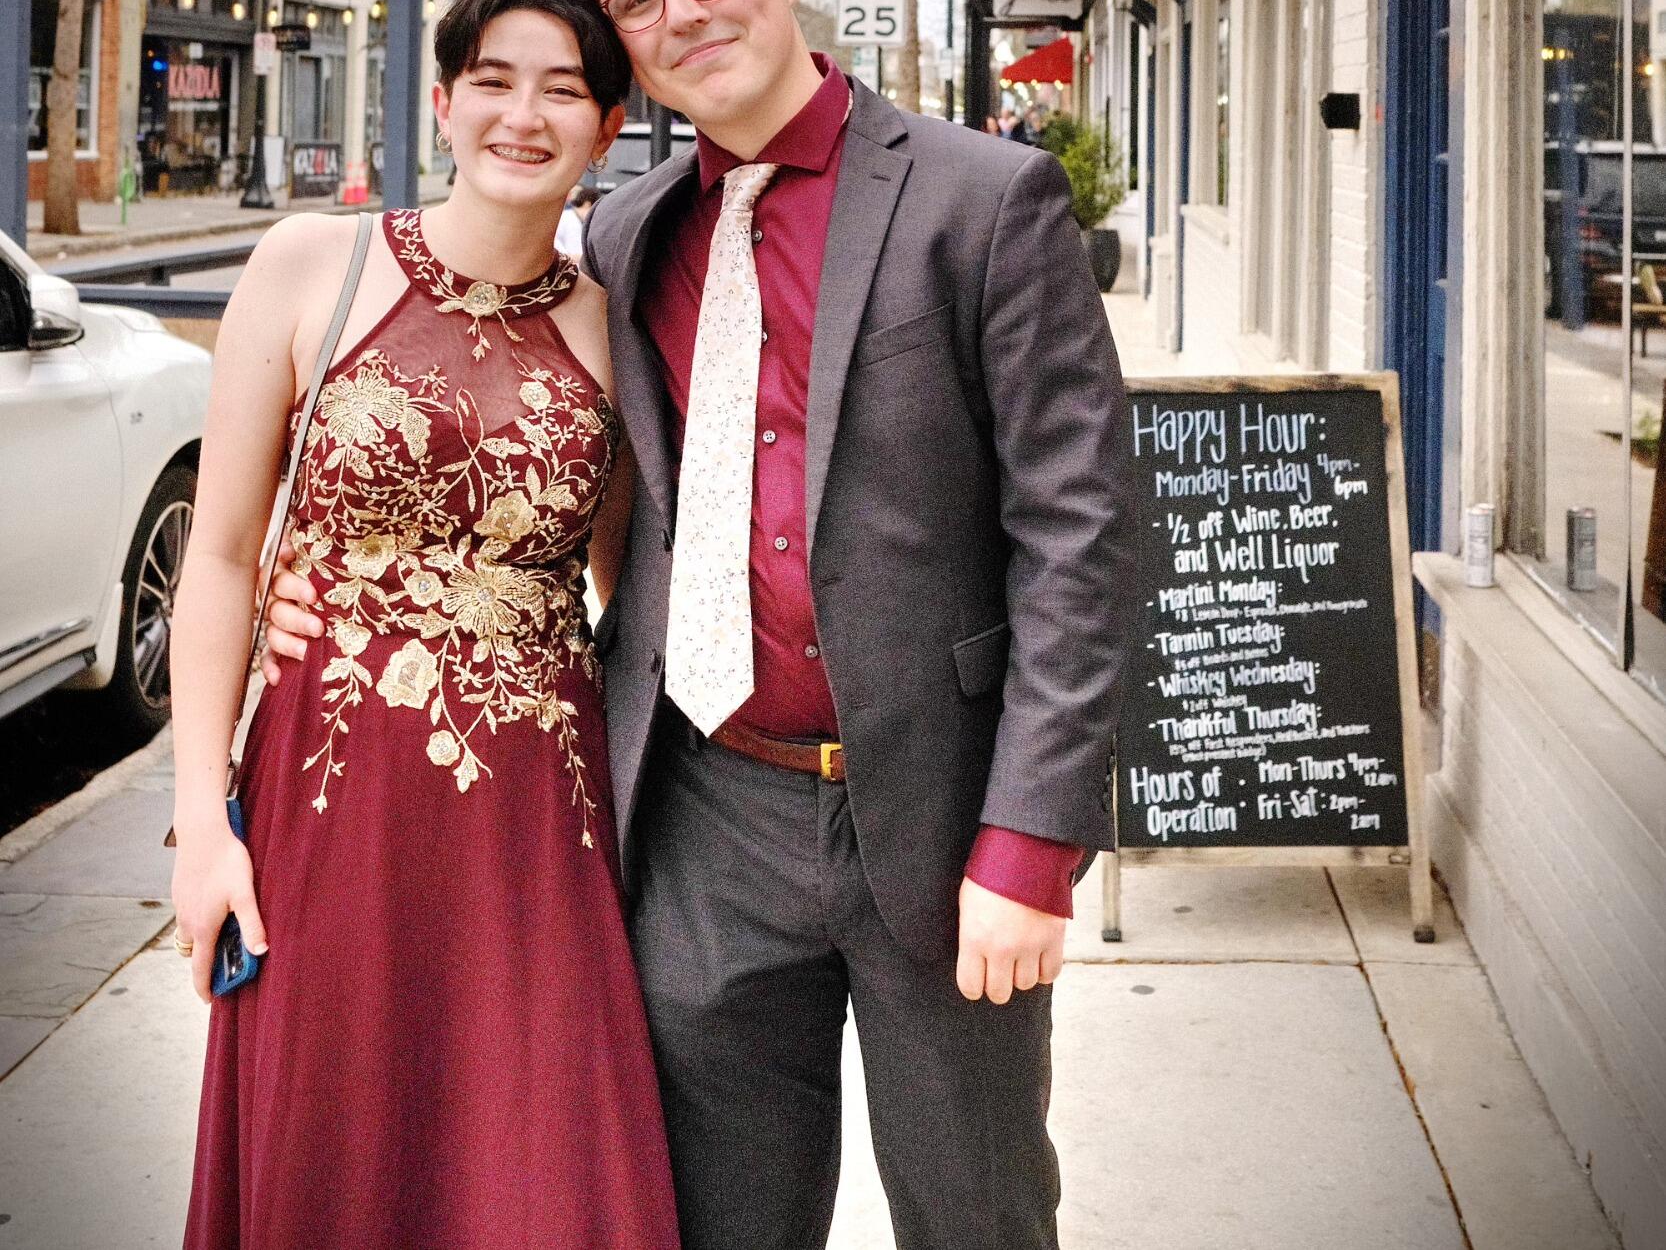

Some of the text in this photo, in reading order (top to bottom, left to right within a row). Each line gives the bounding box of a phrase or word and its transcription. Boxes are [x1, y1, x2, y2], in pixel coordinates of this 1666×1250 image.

[843, 6, 897, 37] 25
[1132, 403, 1326, 466] Happy Hour:
[1155, 458, 1312, 506] Monday-Friday
[1334, 474, 1369, 500] 6pm
[1198, 510, 1224, 540] off
[1174, 533, 1340, 584] and Well Liquor
[1158, 581, 1215, 613] Martini
[1218, 575, 1284, 608] Monday:
[1154, 619, 1286, 656] Tannin Tuesday:
[1158, 669, 1227, 698] Whiskey
[1230, 656, 1321, 695] Wednesday:
[1156, 710, 1238, 742] Thankful
[1243, 698, 1323, 733] Thursday:
[1130, 765, 1223, 805] Hours of
[1258, 755, 1347, 784] Mon-Thurs
[1364, 771, 1398, 787] 12am
[1147, 800, 1238, 841] Operation
[1350, 813, 1381, 831] 2am
